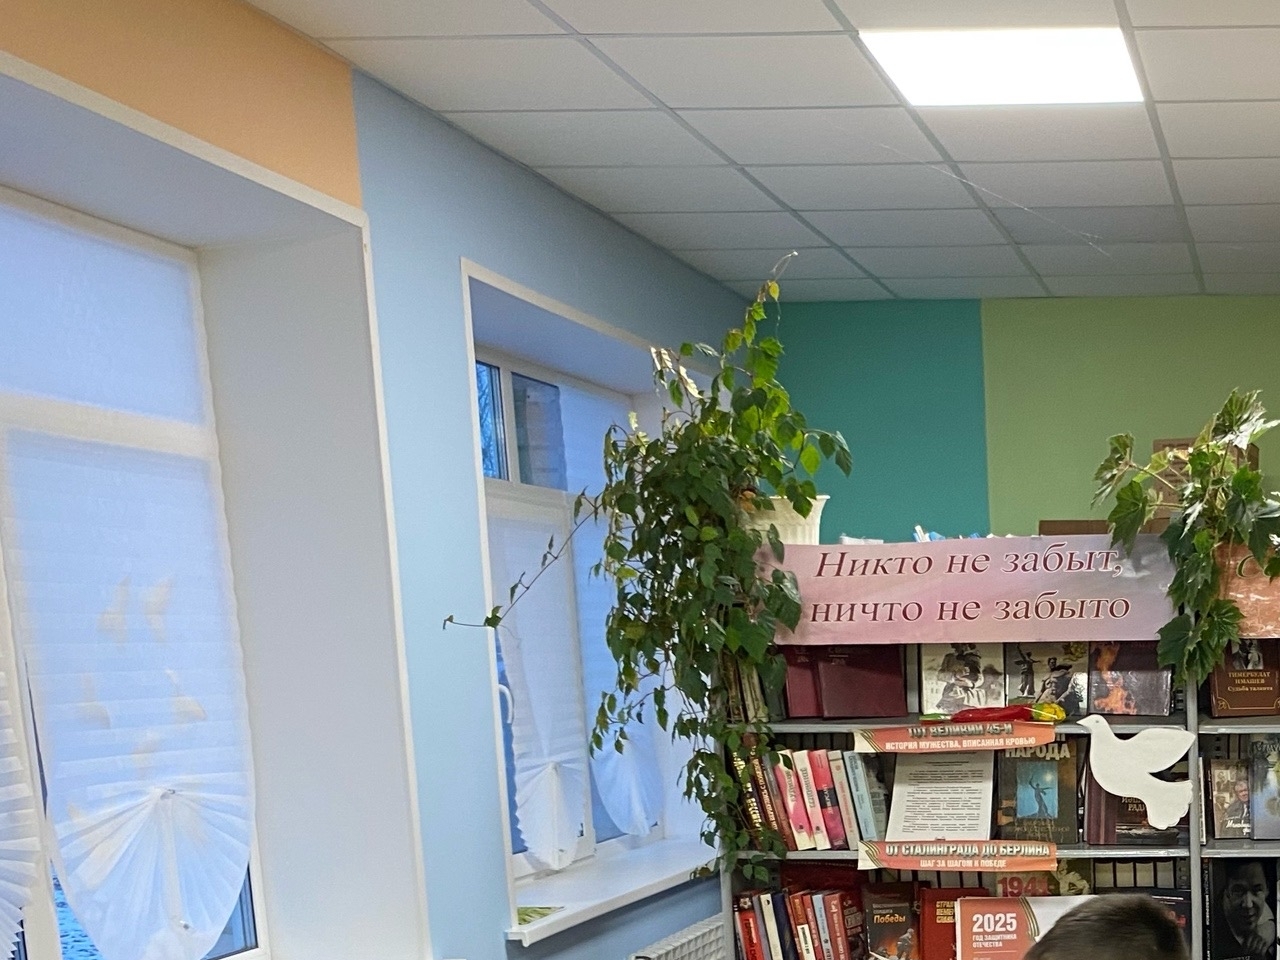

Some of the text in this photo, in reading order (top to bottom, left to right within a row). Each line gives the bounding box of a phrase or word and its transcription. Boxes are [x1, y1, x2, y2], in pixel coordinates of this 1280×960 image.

[814, 541, 1126, 579] Никто не забыт,
[811, 589, 1132, 625] ничто не забыто
[885, 736, 1037, 750] ИСТОРИЯ МУЖЕСТВА, ВПИСАННАЯ КРОВЬЮ
[1005, 742, 1071, 761] НАРОДА
[886, 844, 1050, 857] ОТ СТАЛИНГРАДА ДО БЕРЛИНА
[920, 860, 936, 868] ШАГ
[936, 860, 947, 868] ЗА
[947, 860, 973, 868] ШАГОМ
[980, 859, 1007, 868] ПОБЕДЕ
[874, 913, 906, 924] Победы
[972, 912, 1018, 933] 2025
